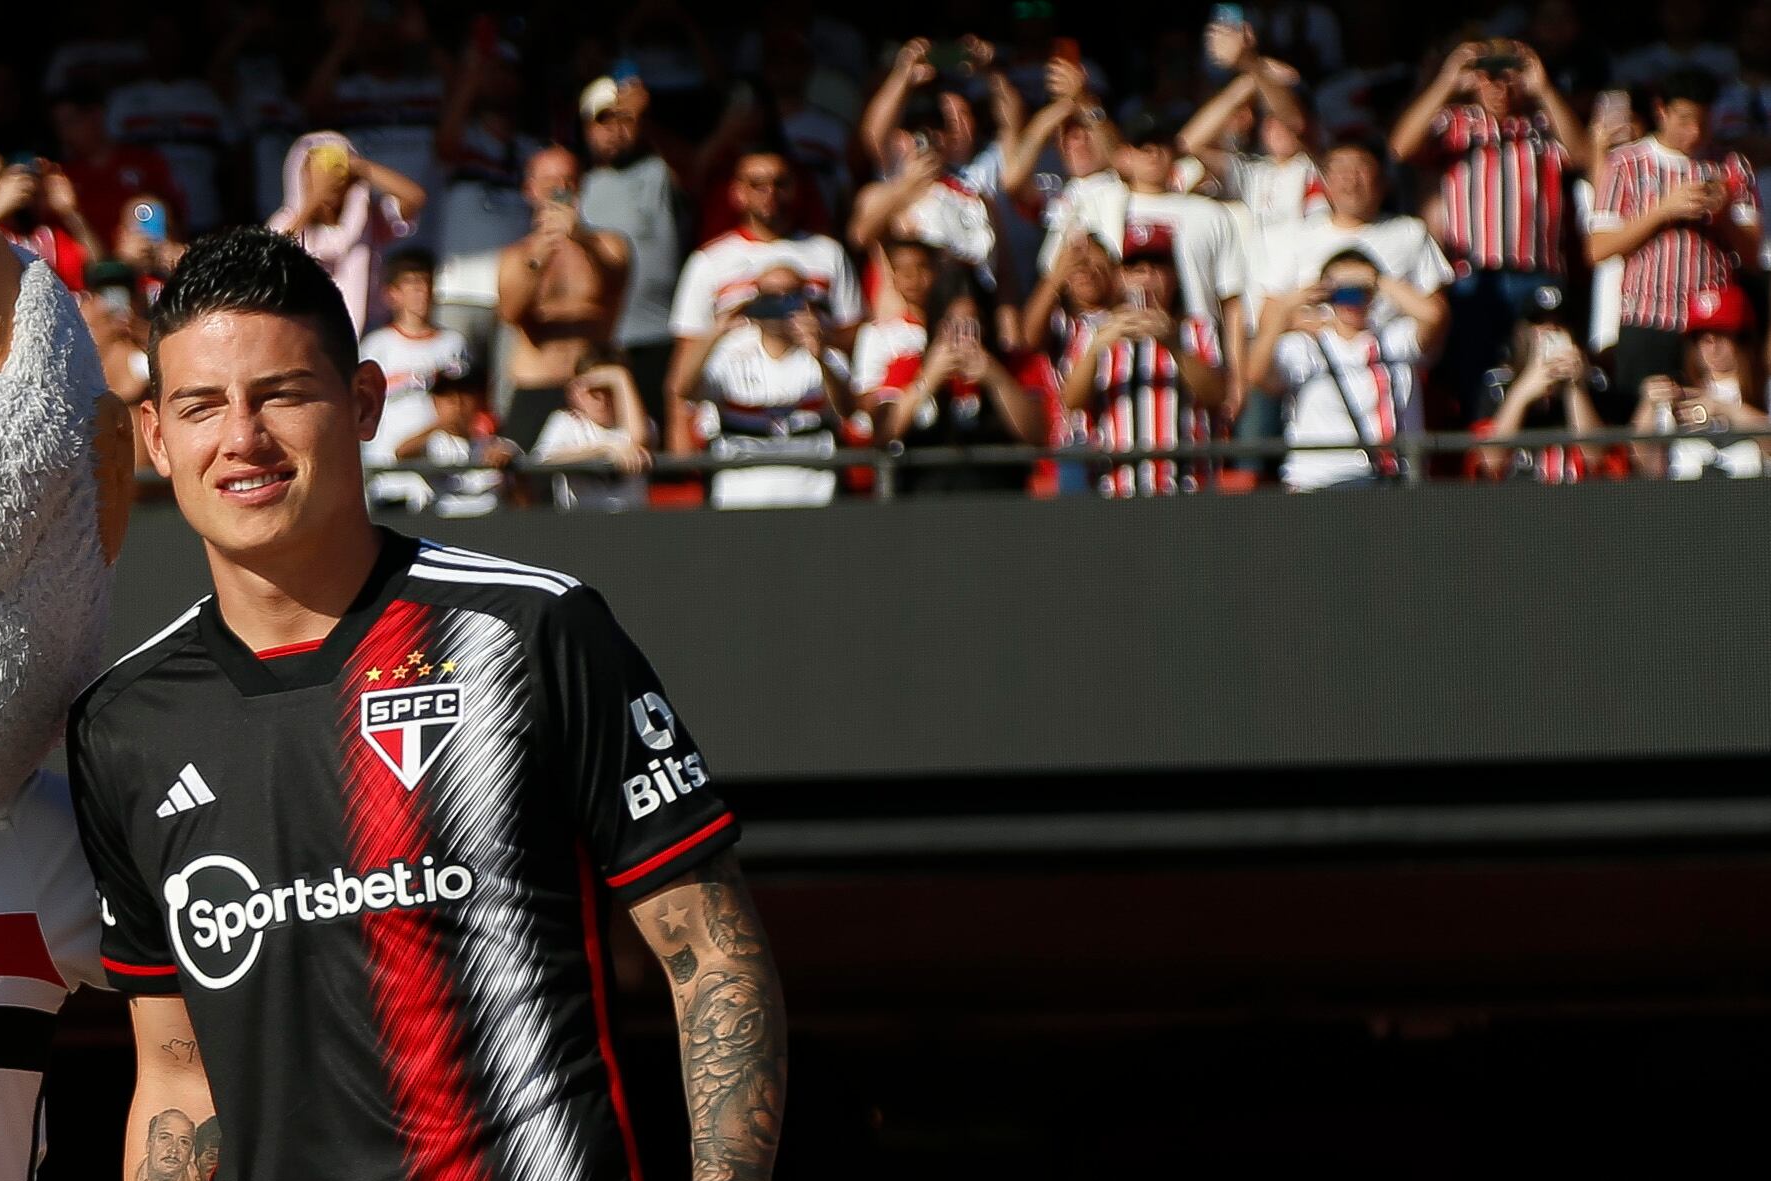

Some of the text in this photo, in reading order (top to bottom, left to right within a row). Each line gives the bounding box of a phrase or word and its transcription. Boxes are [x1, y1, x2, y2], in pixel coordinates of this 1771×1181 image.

[370, 694, 457, 723] SPFC
[623, 752, 709, 821] Bits
[189, 856, 473, 953] Sportsbet.io
